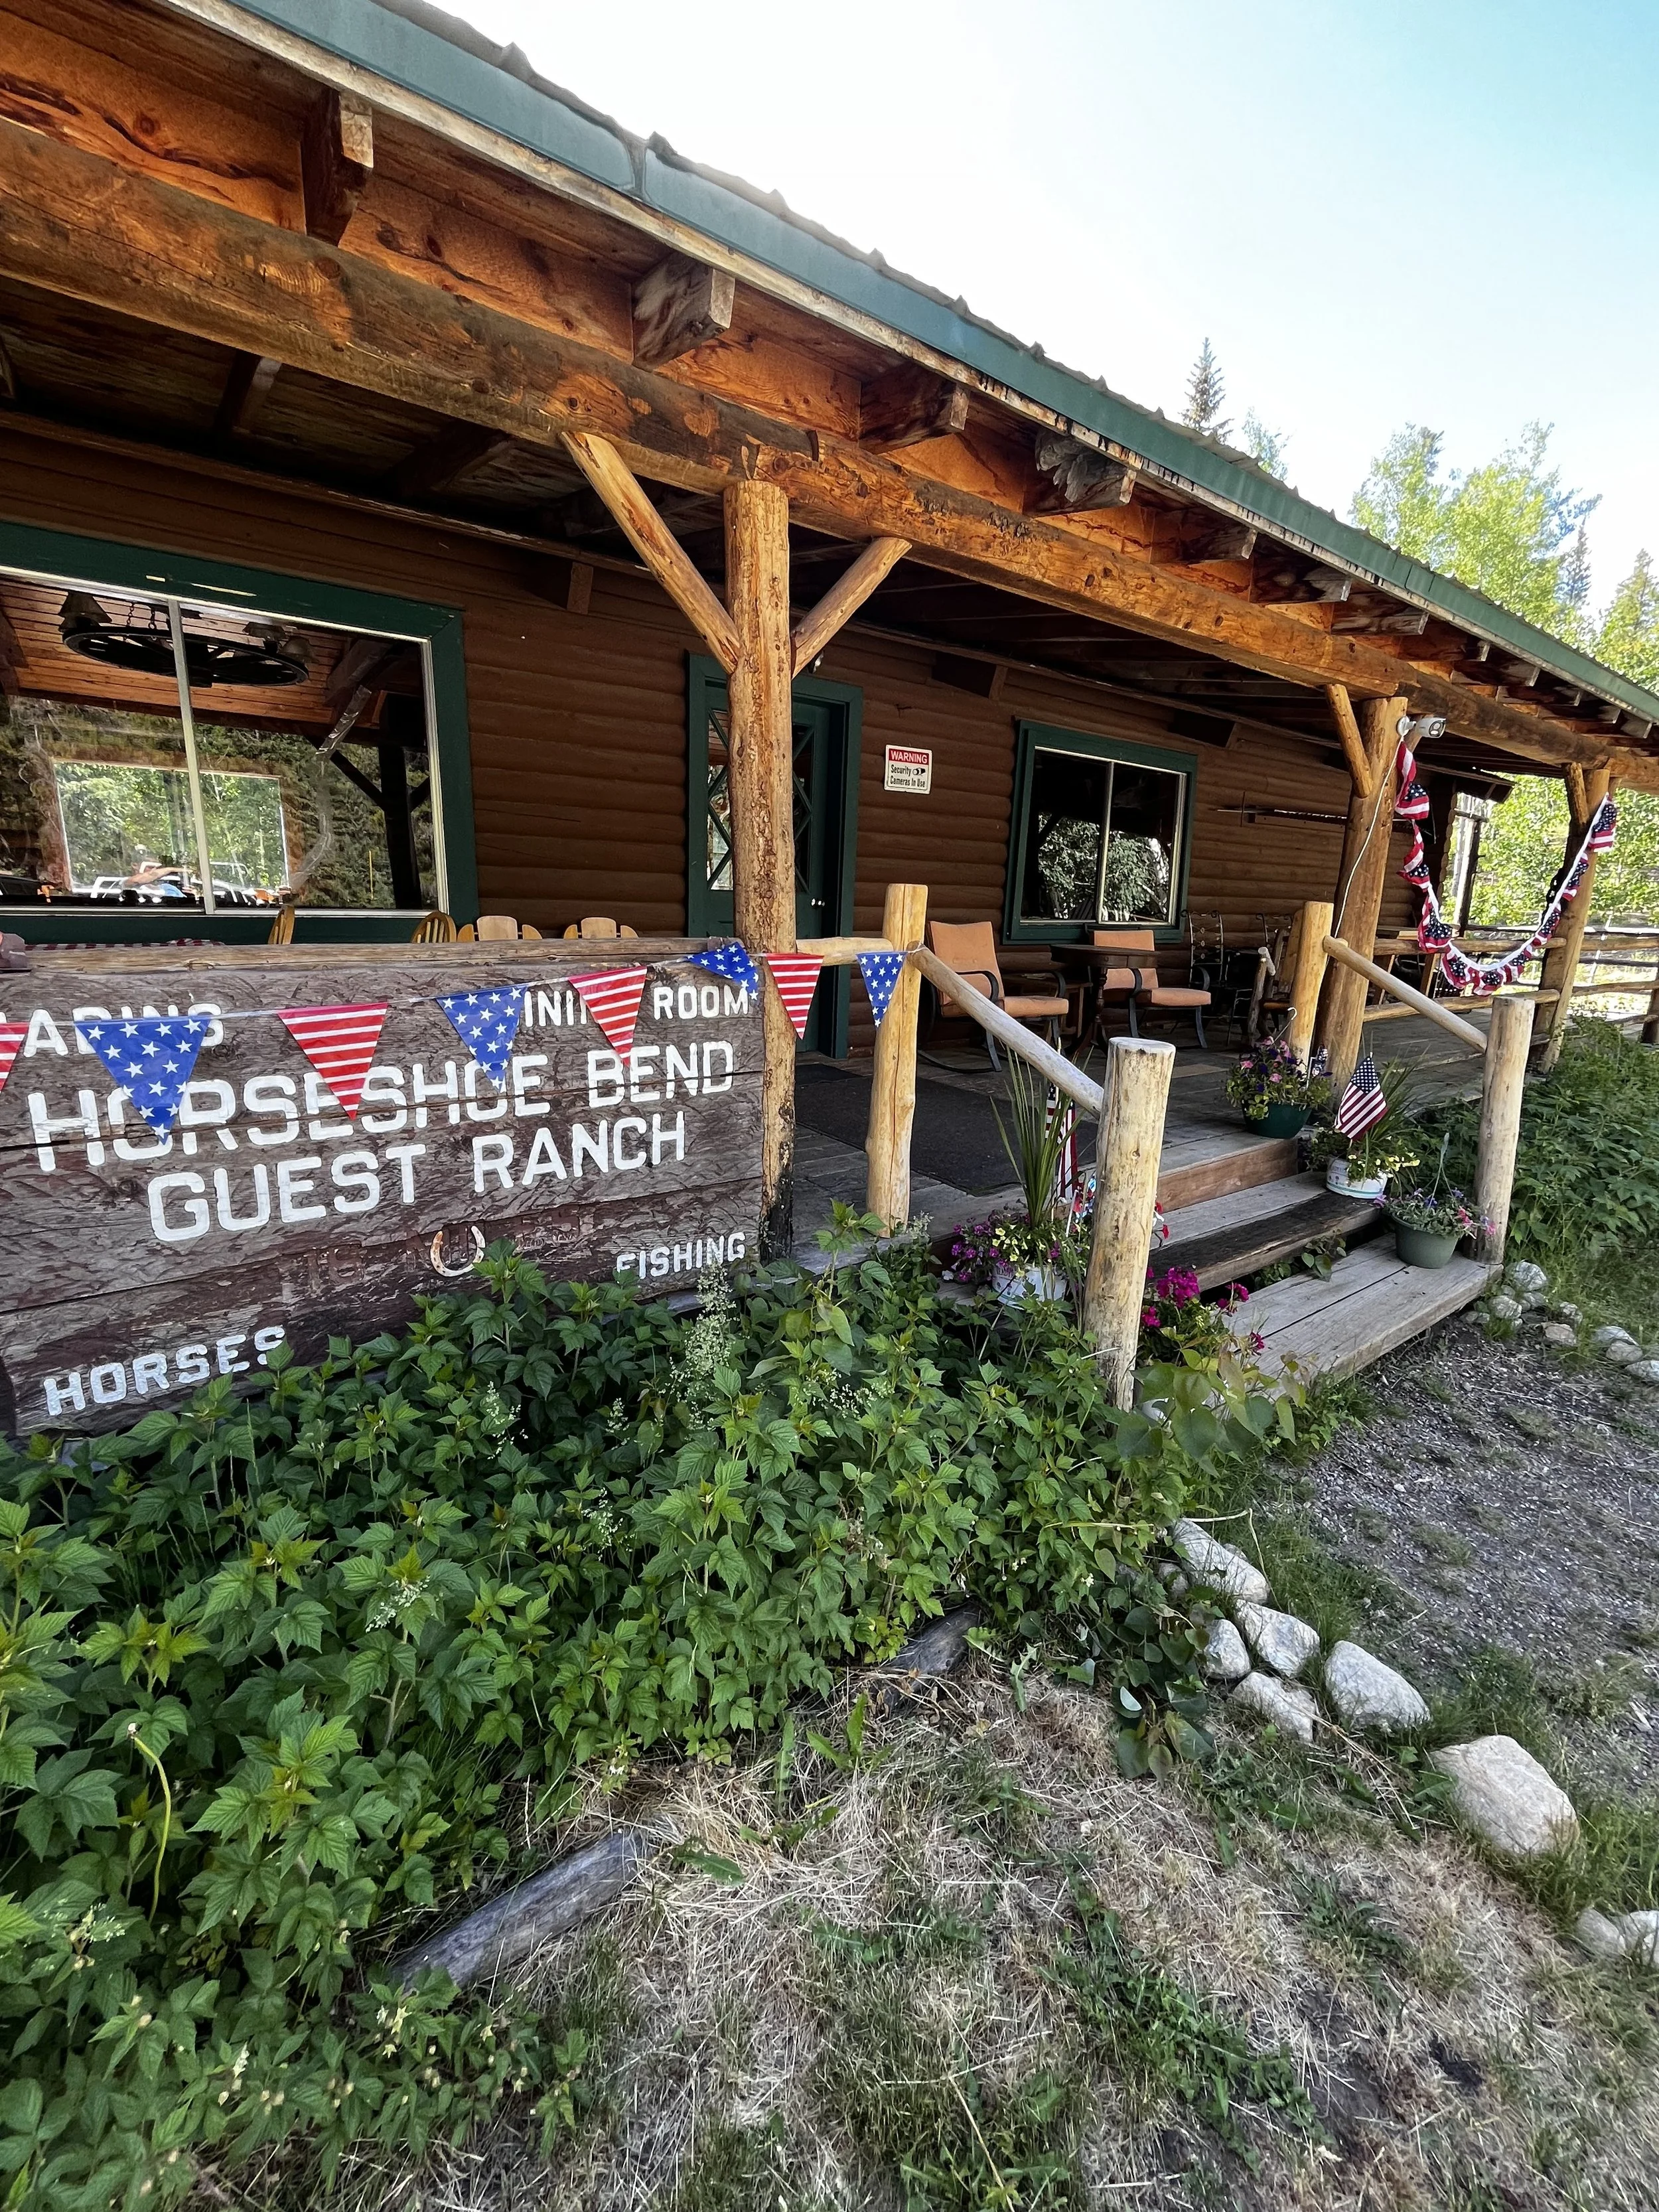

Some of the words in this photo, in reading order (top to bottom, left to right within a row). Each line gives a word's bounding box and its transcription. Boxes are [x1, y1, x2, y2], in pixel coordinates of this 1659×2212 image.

[891, 750, 928, 764] WARNING
[891, 765, 912, 776] Security
[890, 775, 910, 786] Cameras
[911, 778, 916, 786] In
[653, 984, 749, 1021] ROOM
[27, 1054, 551, 1172] HORSESHOE
[587, 1040, 733, 1108] BEND
[147, 1143, 427, 1242] GUEST
[473, 1110, 685, 1193] RANCH
[616, 1232, 745, 1280] FISHING
[43, 1325, 285, 1416] HORSES
